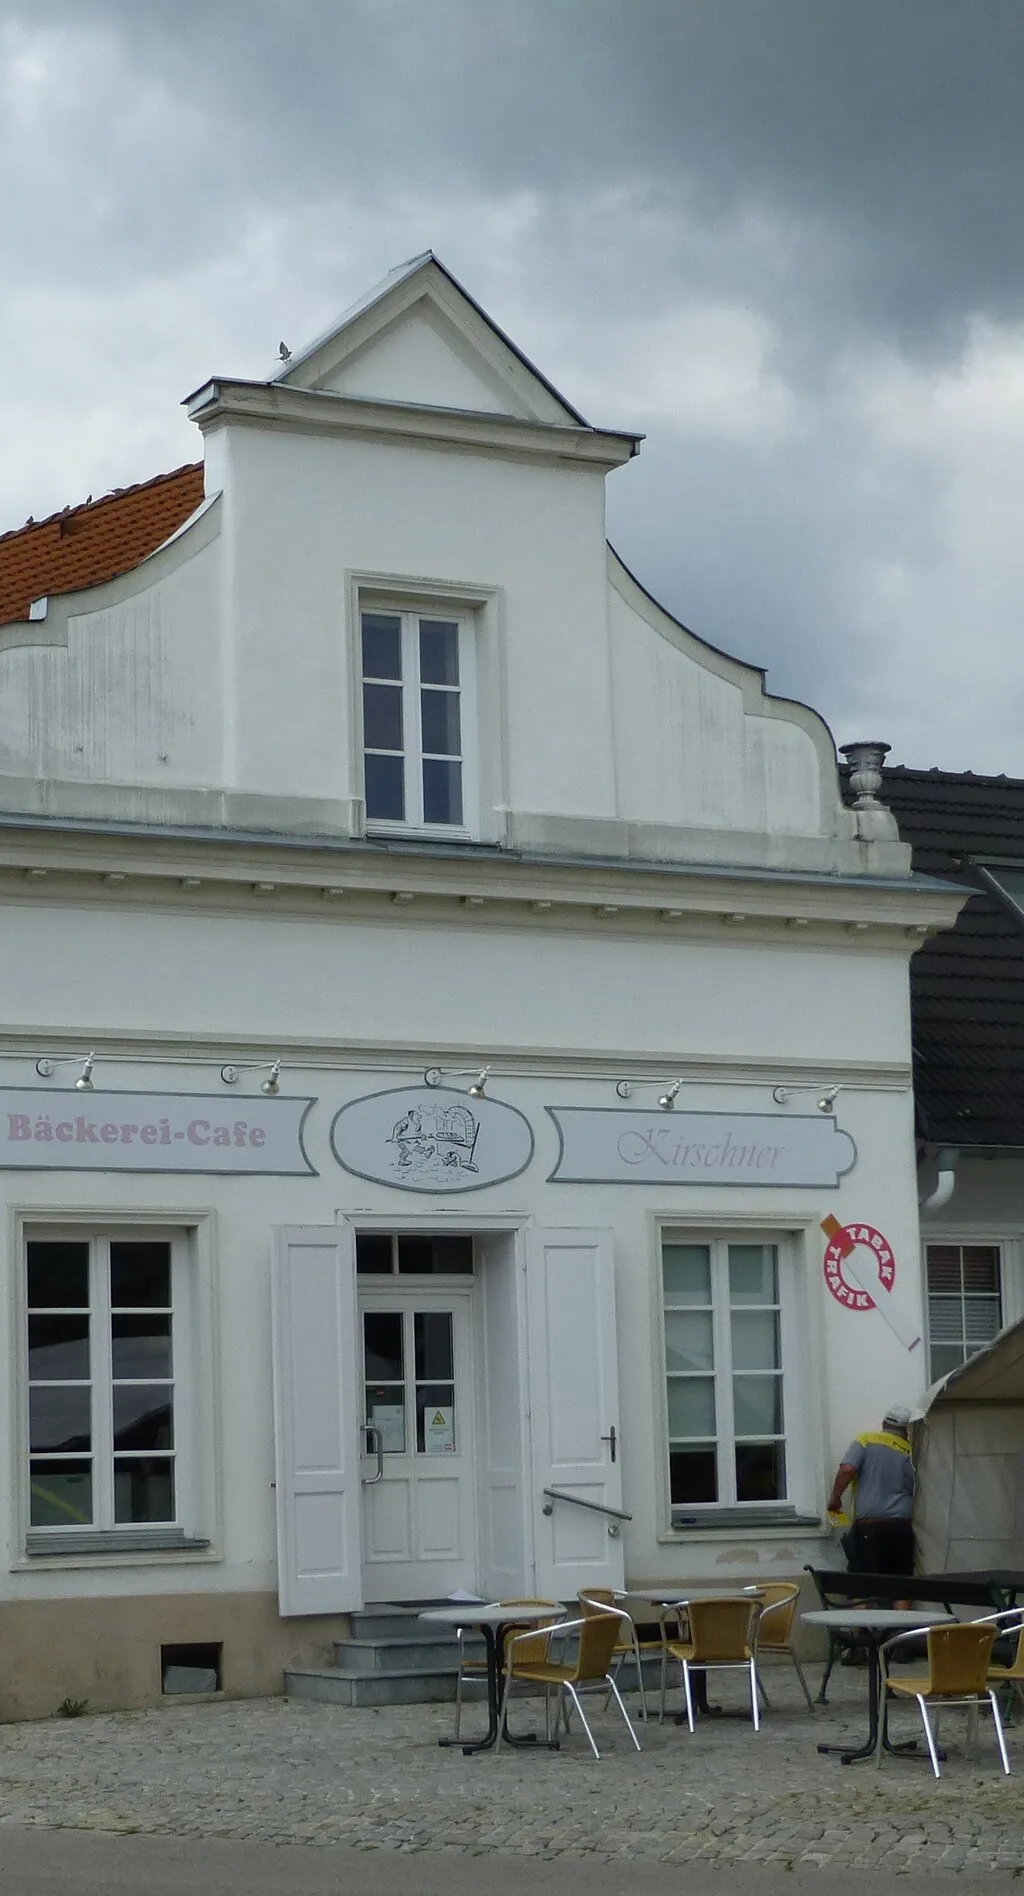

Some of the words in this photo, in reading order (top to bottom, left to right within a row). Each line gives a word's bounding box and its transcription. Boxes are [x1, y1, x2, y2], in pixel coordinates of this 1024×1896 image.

[8, 1113, 267, 1148] Bäckerei-Cafe
[617, 1128, 786, 1168] Kirschner
[827, 1246, 869, 1307] TRAFIK
[846, 1227, 893, 1280] TABAK
